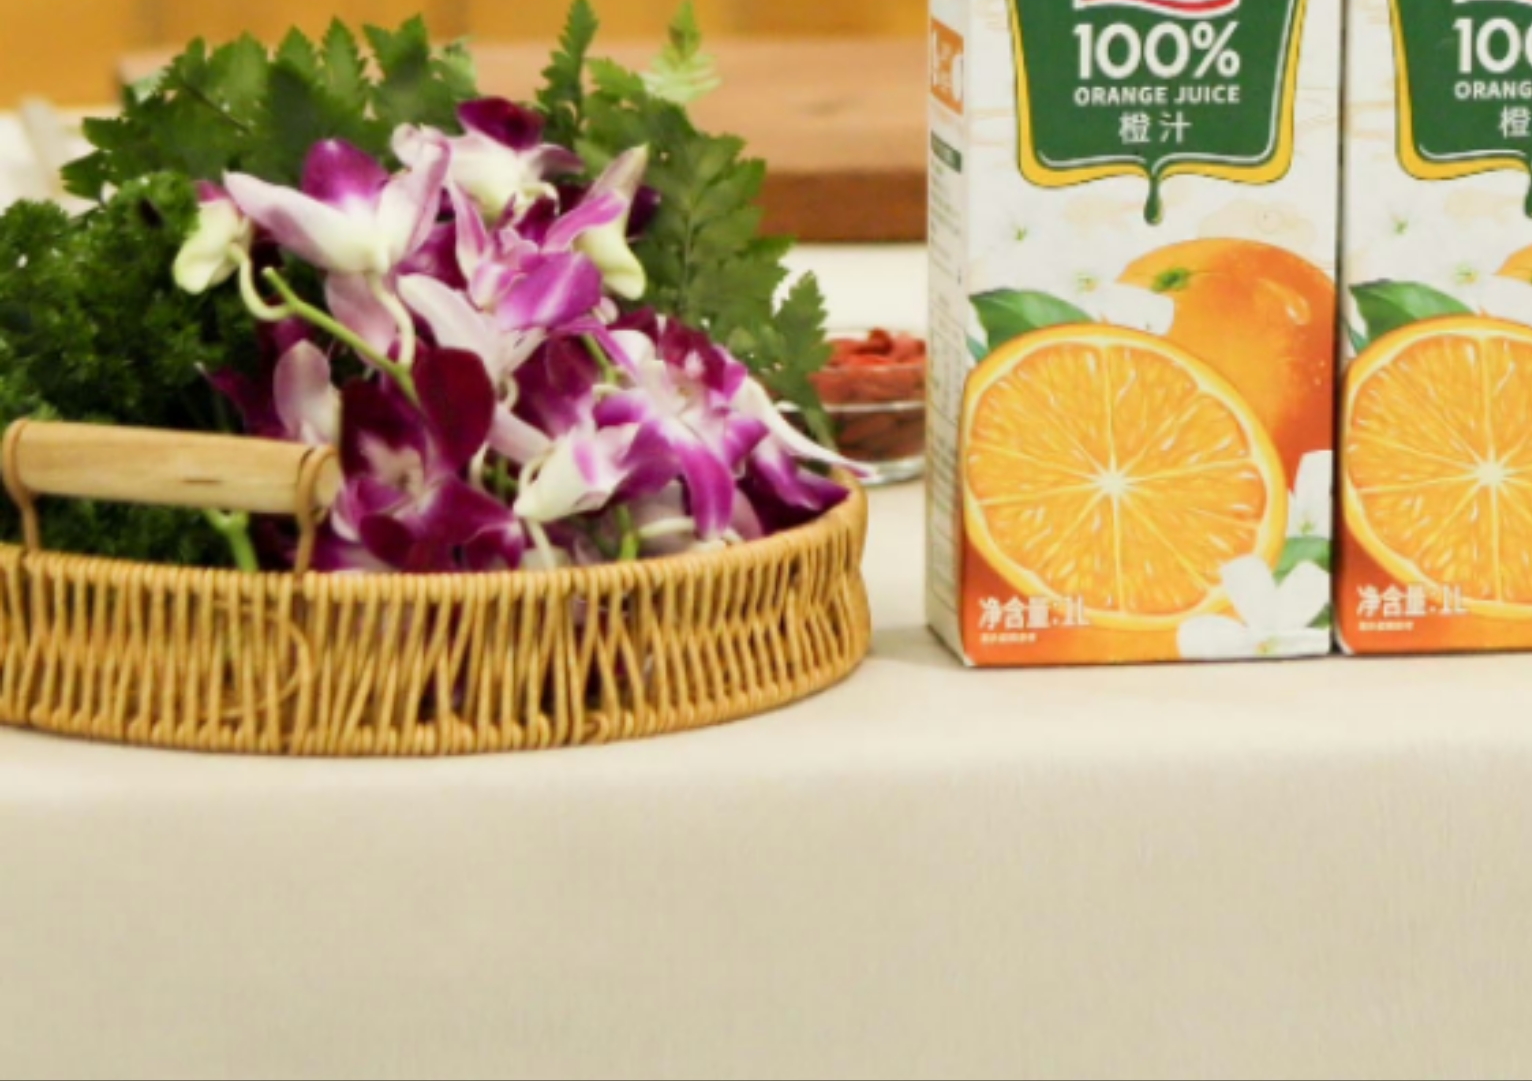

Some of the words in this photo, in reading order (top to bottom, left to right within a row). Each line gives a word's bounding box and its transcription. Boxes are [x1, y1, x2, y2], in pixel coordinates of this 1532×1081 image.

[1073, 21, 1241, 80] 100%
[1074, 86, 1168, 106] ORANGE
[1173, 84, 1241, 104] JUICE
[1119, 110, 1192, 144] 橙汁
